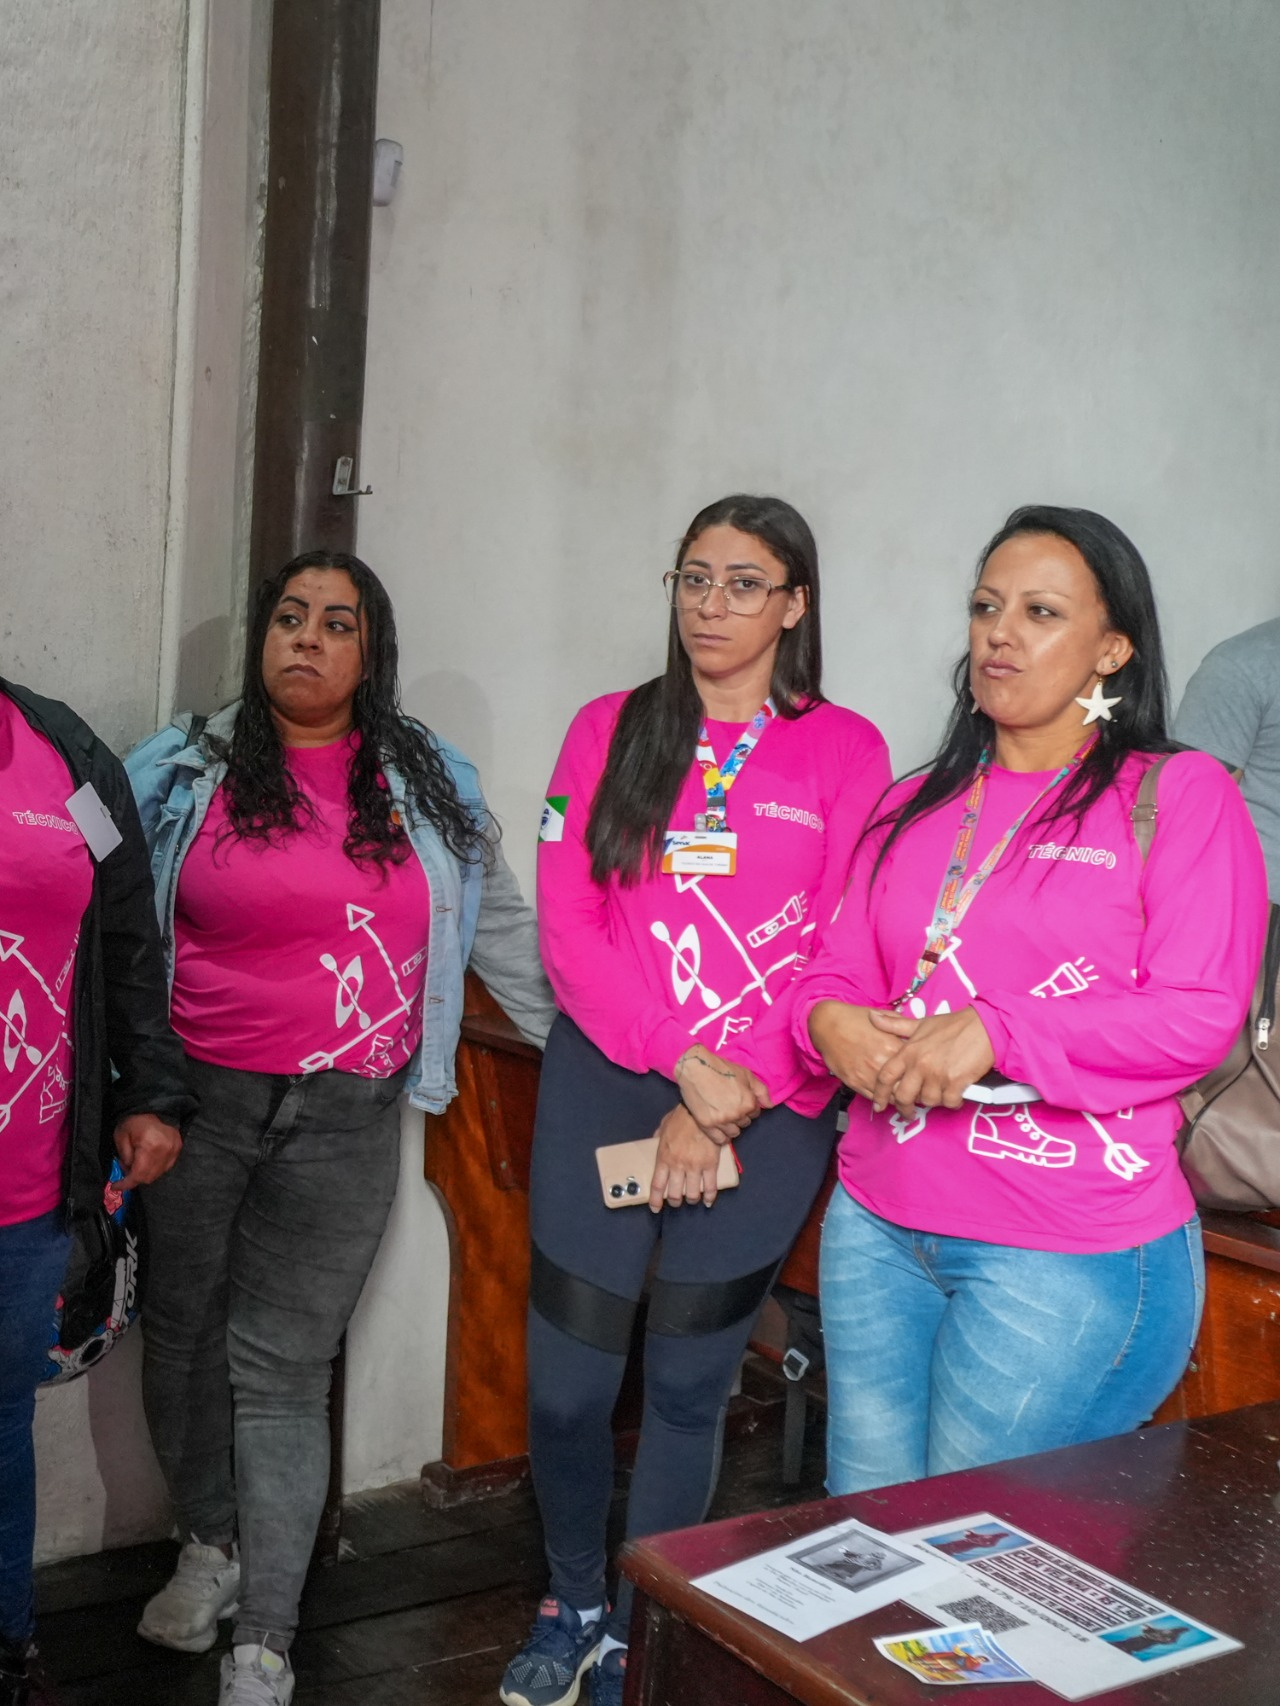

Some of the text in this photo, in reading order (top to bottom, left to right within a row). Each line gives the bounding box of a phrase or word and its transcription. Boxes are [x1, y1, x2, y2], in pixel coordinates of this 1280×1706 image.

[1028, 841, 1117, 870] TÉCNICO
[117, 1227, 139, 1328] TORK
[1039, 1566, 1092, 1592] VELINHA
